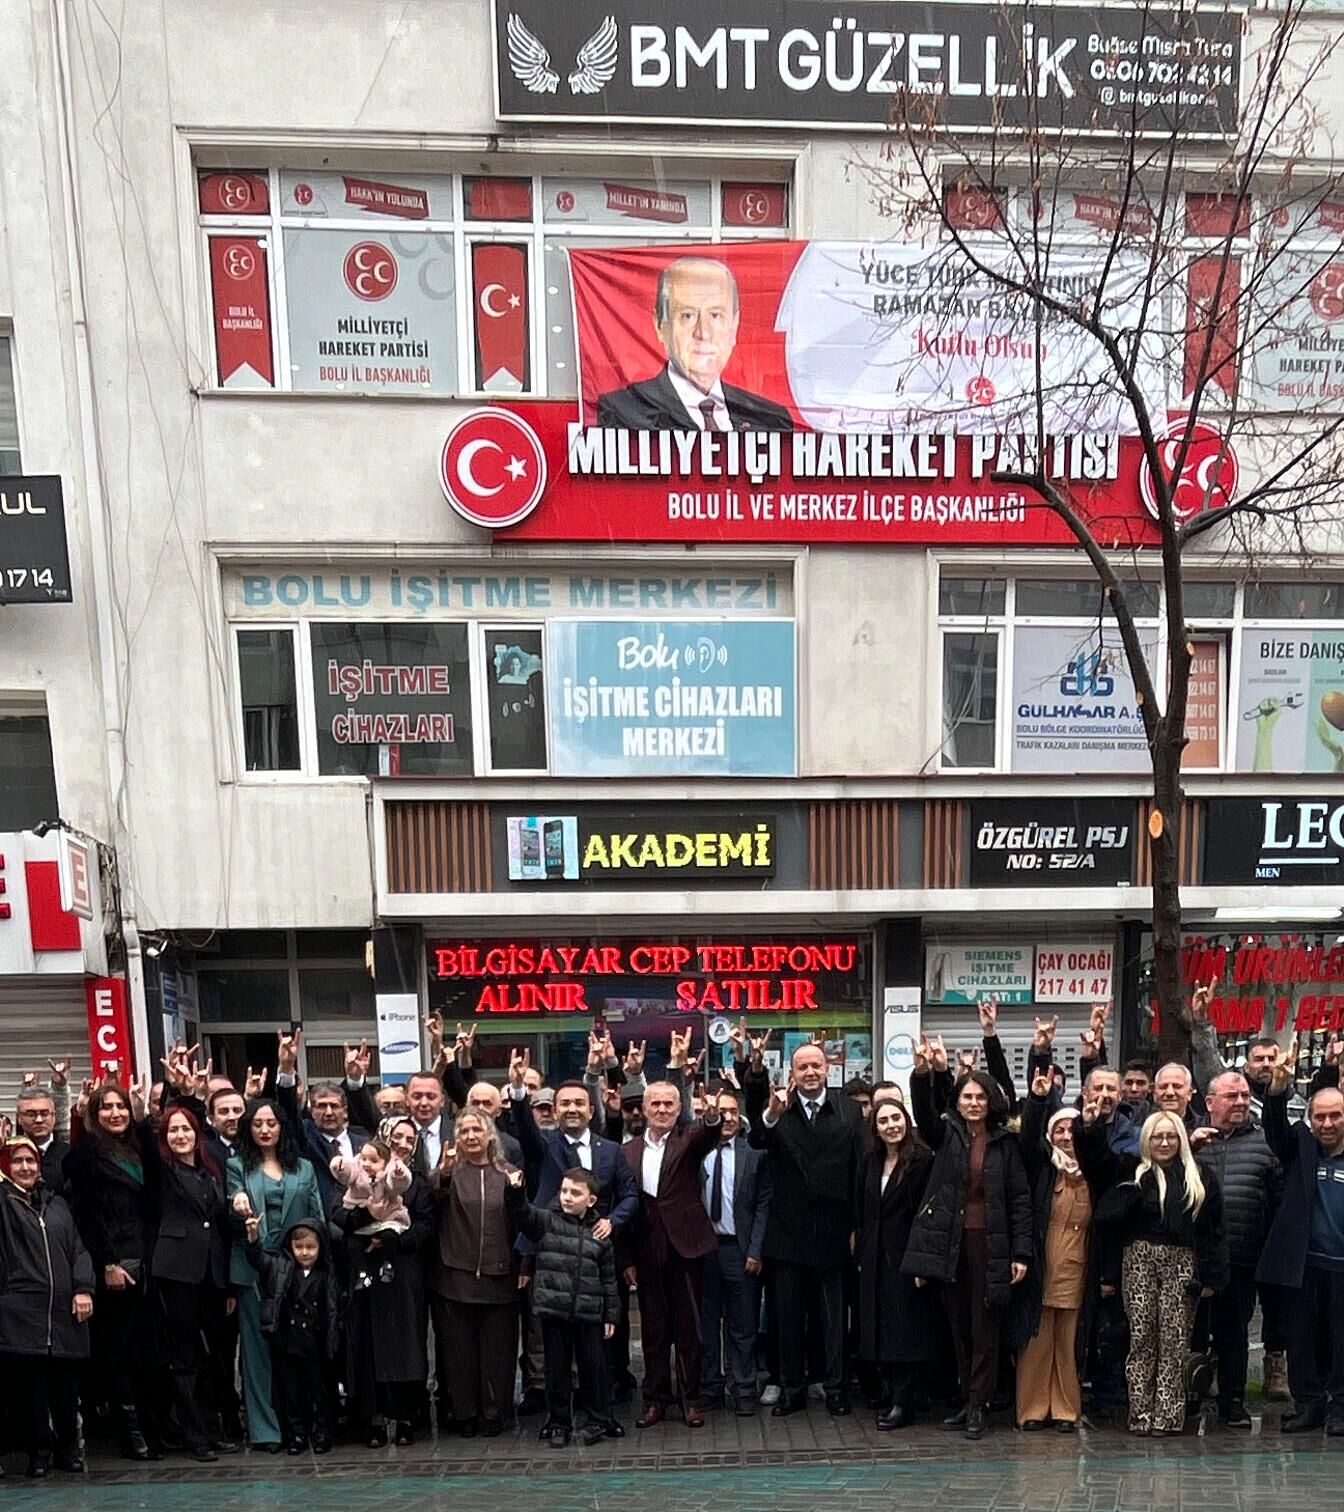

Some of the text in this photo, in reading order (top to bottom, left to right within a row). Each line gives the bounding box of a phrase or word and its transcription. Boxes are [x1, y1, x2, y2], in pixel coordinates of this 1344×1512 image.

[630, 17, 1078, 99] BMT GÜZELLİK
[861, 260, 919, 285] YÜCE
[873, 293, 981, 319] RAMAZAN
[337, 316, 408, 337] MİLLİYETÇİ
[318, 340, 429, 359] HAREKET PARTİSİ
[912, 323, 977, 358] Kutlu
[319, 363, 431, 385] BOLU İL BAŞKANLIĞI
[1279, 358, 1332, 373] HAREKET
[793, 432, 956, 478] HAREKET
[668, 489, 1026, 525] BOLU İL VE MERKEZ İLÇE BAŞKANLIĞI
[6, 569, 27, 589] 17
[30, 568, 54, 588] 14
[242, 567, 777, 612] BOLU İŞİTME MERKEZİ
[617, 632, 679, 671] Bolu
[1260, 638, 1294, 659] BİZE
[327, 659, 450, 701] İŞİTME
[564, 676, 783, 723] İŞİTME CİHAZLARI
[332, 708, 455, 744] CİHAZLARI
[622, 718, 726, 757] MERKEZİ
[1117, 742, 1148, 751] MERKEZ
[582, 823, 771, 868] AKADEMİ
[977, 822, 1129, 849] ÖZGÜREL PSJ
[1006, 854, 1095, 869] NO: 52/A
[1255, 867, 1281, 878] MEN
[436, 943, 856, 977] BİLGİSAYAR CEP TELEFONU
[965, 951, 1022, 961] SIEMENS
[971, 963, 1015, 974] İŞİTME
[1038, 949, 1112, 974] ÇAY OCAĞI
[1181, 935, 1227, 984] ÜM
[958, 975, 1027, 986] CİHAZLARI
[1039, 978, 1109, 996] 217 41 47
[475, 979, 819, 1013] ALINIR SATILIR
